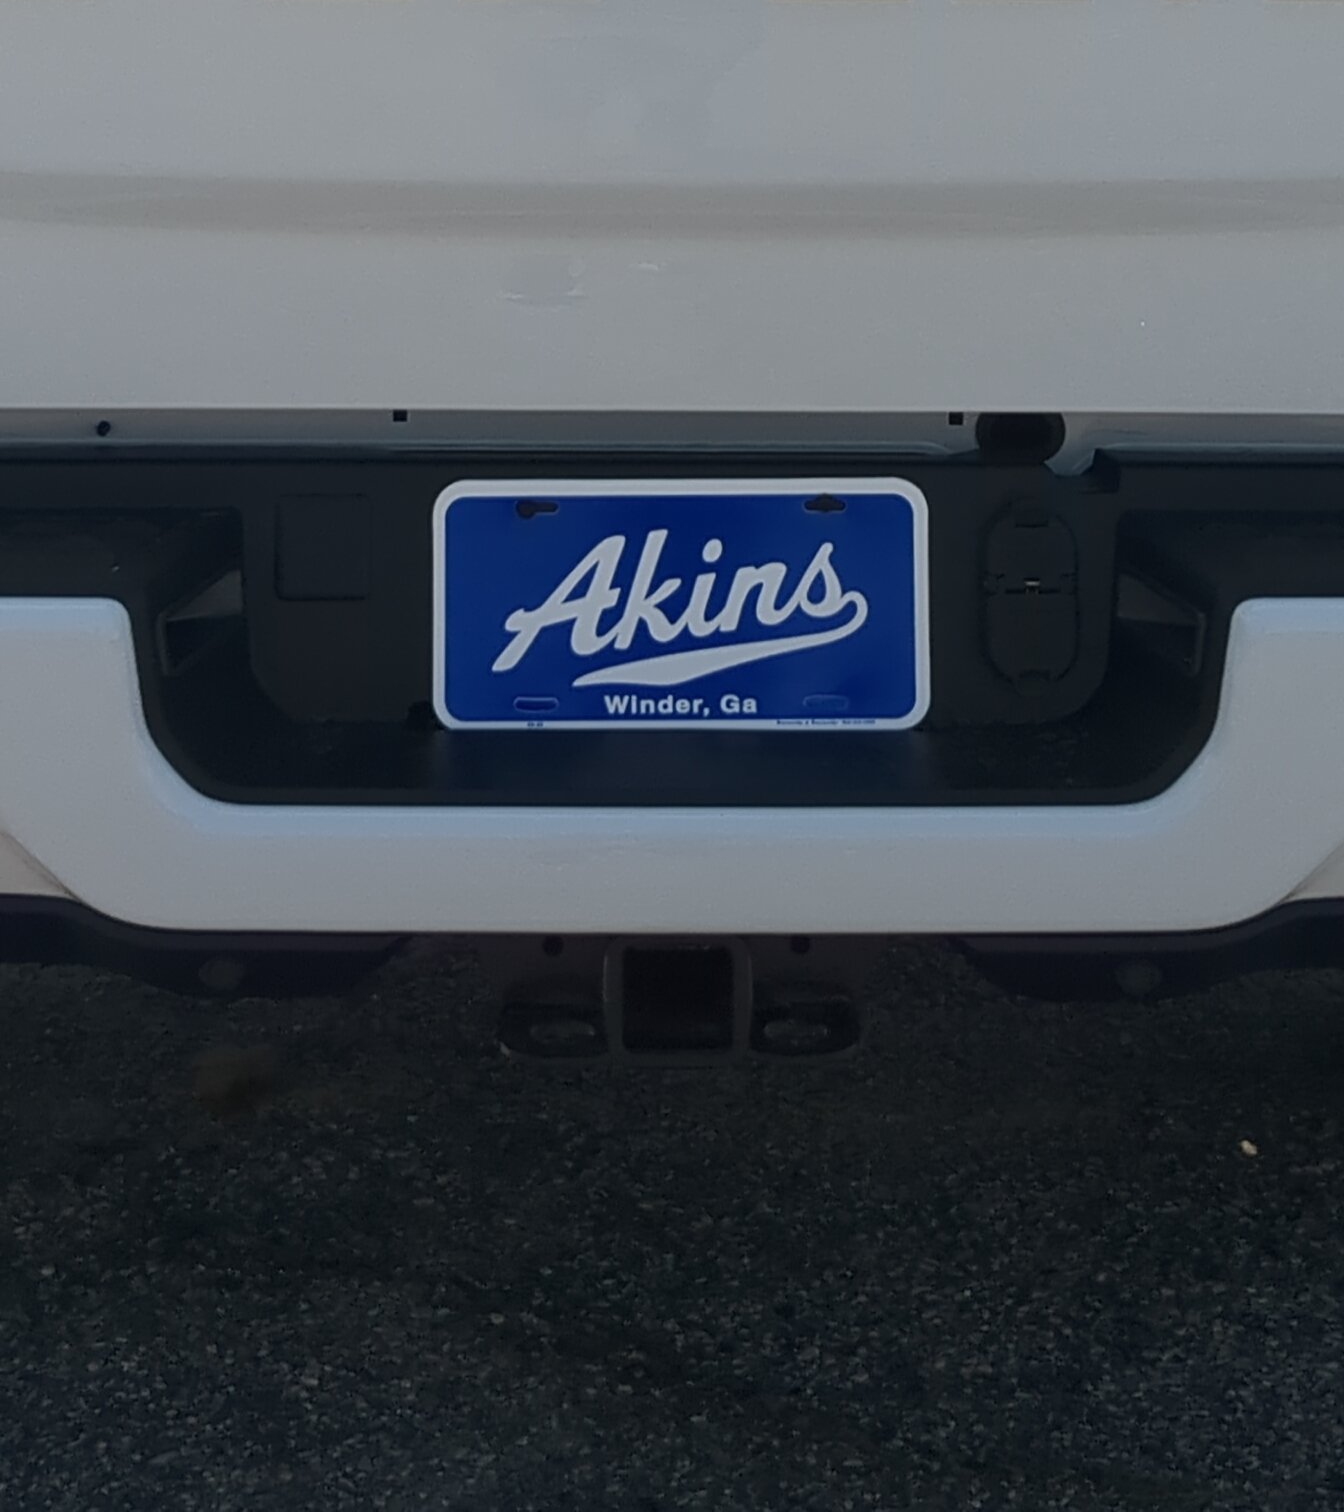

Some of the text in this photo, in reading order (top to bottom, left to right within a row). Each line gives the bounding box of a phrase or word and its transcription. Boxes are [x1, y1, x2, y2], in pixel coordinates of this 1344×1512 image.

[492, 528, 869, 686] Akins
[604, 694, 758, 717] Winder, Ga
